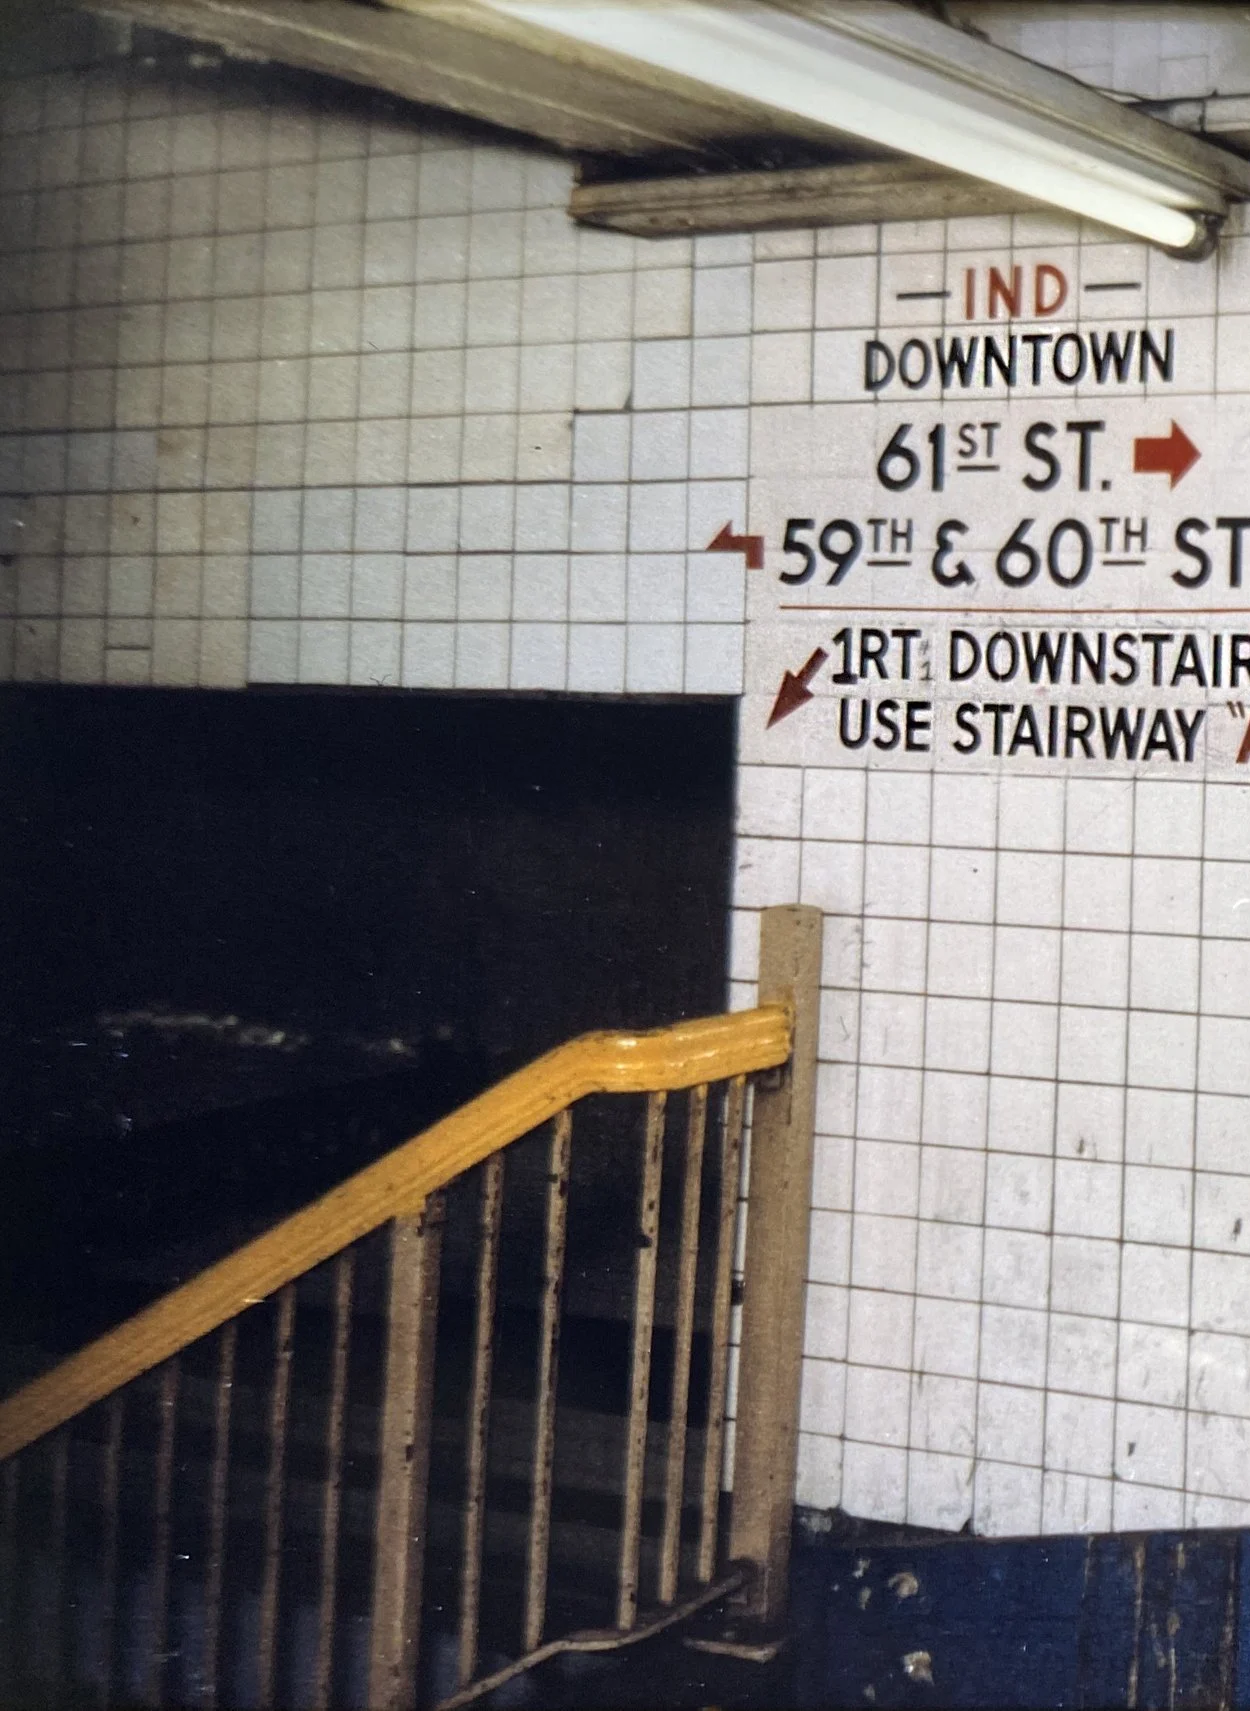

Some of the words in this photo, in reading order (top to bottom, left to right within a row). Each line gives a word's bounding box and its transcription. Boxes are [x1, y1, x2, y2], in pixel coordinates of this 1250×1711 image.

[965, 263, 1069, 321] IND
[864, 329, 1175, 392] DOWNTOWN
[1022, 419, 1112, 492] ST.
[931, 519, 976, 589] &
[837, 700, 932, 753] USE
[951, 702, 1207, 764] STAIRWAY
